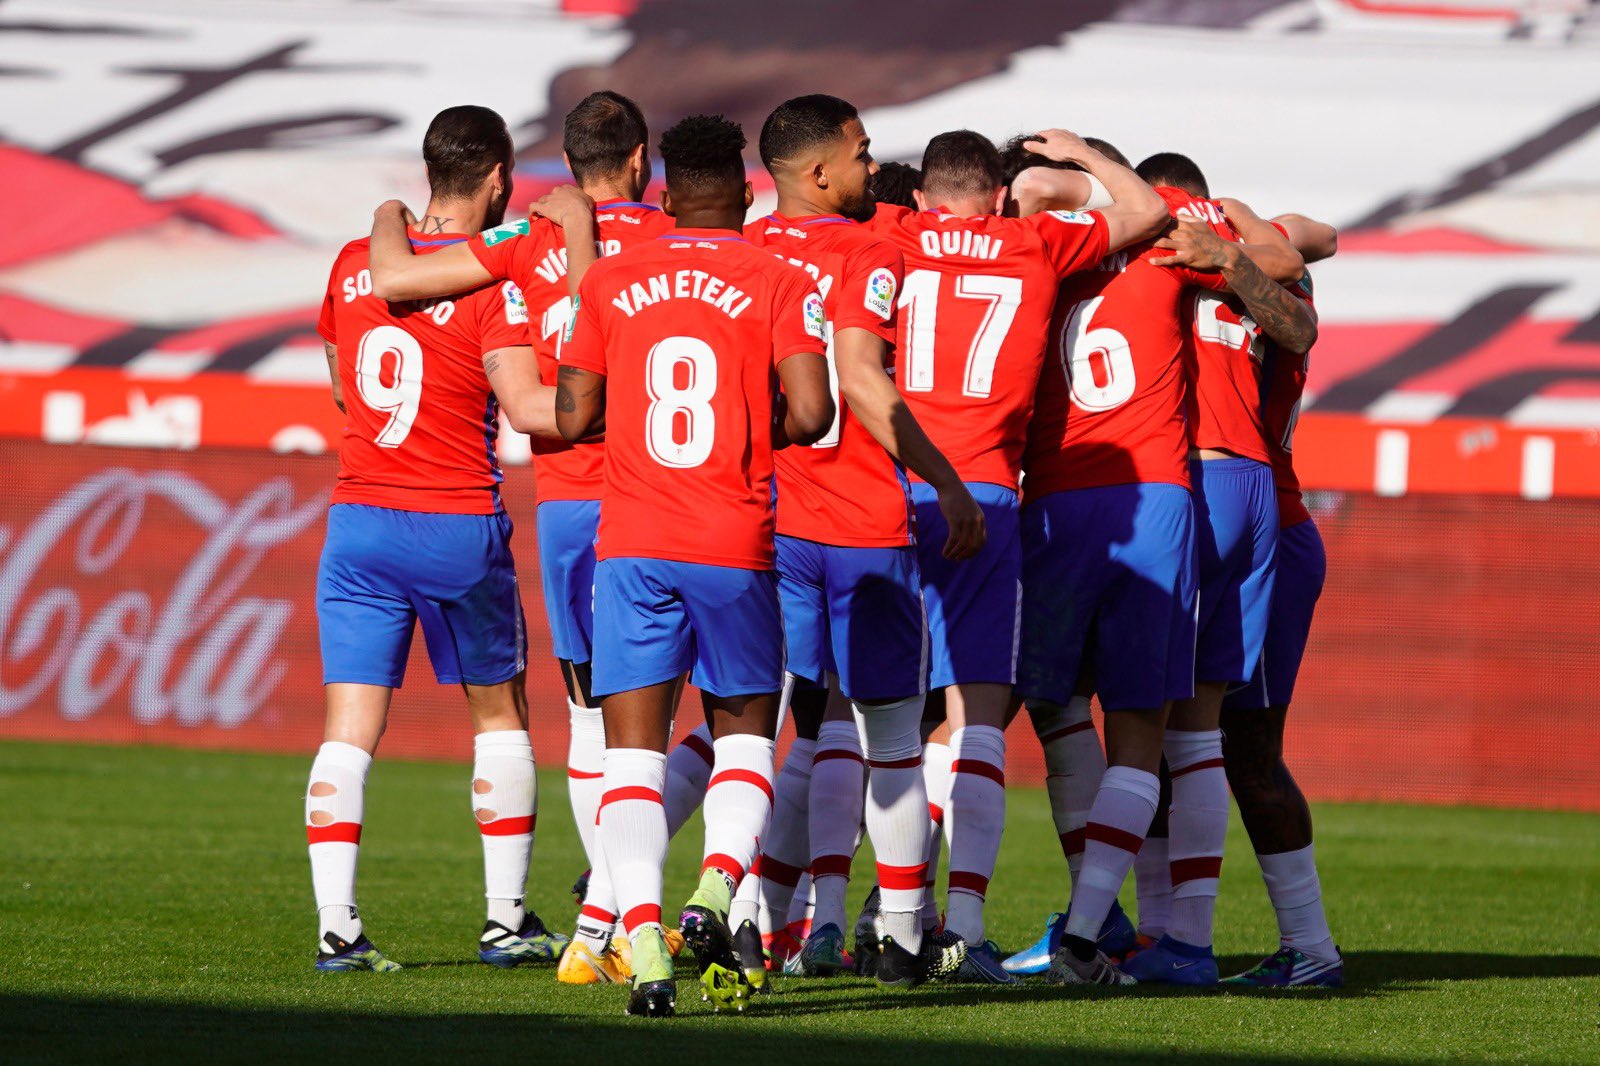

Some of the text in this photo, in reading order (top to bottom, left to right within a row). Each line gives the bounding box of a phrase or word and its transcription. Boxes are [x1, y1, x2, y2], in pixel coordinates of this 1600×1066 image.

[612, 272, 671, 318] YAN
[675, 269, 753, 320] ETEKI
[921, 230, 1003, 261] QUINI
[355, 324, 424, 449] 9
[896, 269, 1023, 399] 17
[1060, 295, 1136, 412] 6
[645, 336, 718, 469] 8
[0, 467, 328, 727] Cola
